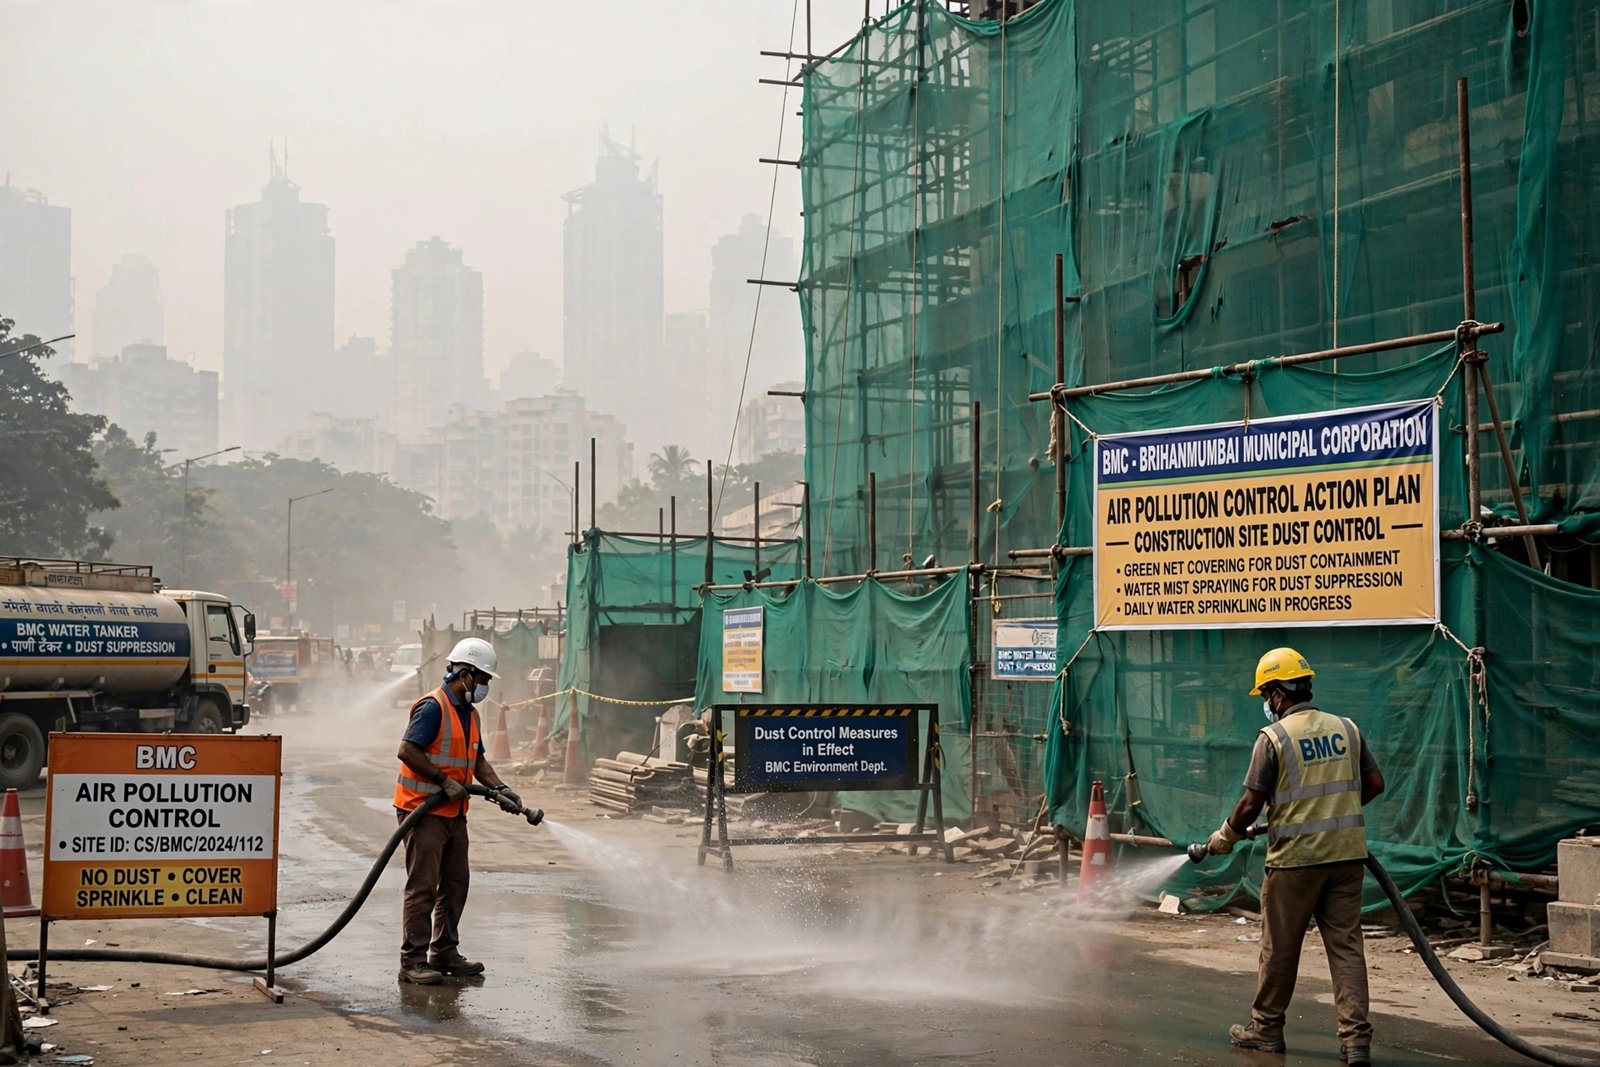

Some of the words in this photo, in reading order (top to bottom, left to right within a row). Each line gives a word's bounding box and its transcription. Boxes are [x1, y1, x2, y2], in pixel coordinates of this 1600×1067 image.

[1102, 448, 1129, 475] BMC
[1139, 436, 1239, 472] BRIHANMUMBAI
[1243, 428, 1317, 463] MUNICIPAL
[1320, 415, 1427, 455] CORPORATION
[1107, 498, 1131, 525] AIR
[1135, 490, 1219, 523] POLLUTION
[1223, 483, 1299, 517] CONTROL
[1304, 479, 1368, 511] ACTION
[1373, 473, 1421, 506] PLAN
[1134, 527, 1235, 553] CONSTRUCTION
[1238, 524, 1268, 548] SITE
[1273, 521, 1309, 545] DUST
[1313, 516, 1385, 543] CONTROL
[1124, 562, 1160, 577] GREEN
[1163, 561, 1184, 575] NET
[1187, 558, 1245, 574] COVERING
[1248, 556, 1272, 572] FOR
[1275, 554, 1307, 570] DUST
[1310, 550, 1400, 569] CONTAINMENT
[1124, 582, 1160, 596] WATER
[1163, 581, 1189, 595] MIST
[1192, 578, 1249, 594] SPRAYING
[1252, 577, 1276, 592] FOR
[1279, 575, 1311, 591] DUST
[1314, 571, 1402, 590] SUPPRESSION
[1124, 601, 1154, 616] DAILY
[1157, 600, 1194, 615] WATER
[1198, 598, 1266, 614] SPRINKLING
[1270, 597, 1281, 612] IN
[1285, 595, 1352, 612] PROGRESS
[17, 623, 45, 636] BMC
[48, 624, 90, 637] WATER
[93, 625, 139, 638] TANKER
[11, 636, 36, 653] पाणी
[75, 641, 104, 653] DUST
[106, 641, 175, 653] SUPPRESSION
[755, 726, 784, 740] Dust
[788, 726, 835, 740] Control
[840, 726, 898, 740] Measures
[802, 743, 814, 756] in
[818, 743, 854, 756] Effect
[1299, 733, 1347, 761] BMC
[136, 745, 197, 770] BMC
[765, 761, 791, 773] BMC
[793, 761, 859, 773] Environment
[861, 760, 887, 775] Dept.
[75, 783, 116, 803] AIR
[123, 783, 252, 803] POLLUTION
[108, 808, 220, 828] CONTROL
[72, 837, 105, 853] SITE
[110, 837, 129, 852] ID:
[134, 836, 263, 852] CS/BMC/2024/112
[81, 868, 108, 886] NO
[114, 868, 161, 886] DUST
[183, 867, 241, 885] COVER
[76, 889, 165, 908] SPRINKLE
[185, 888, 243, 905] CLEAN
